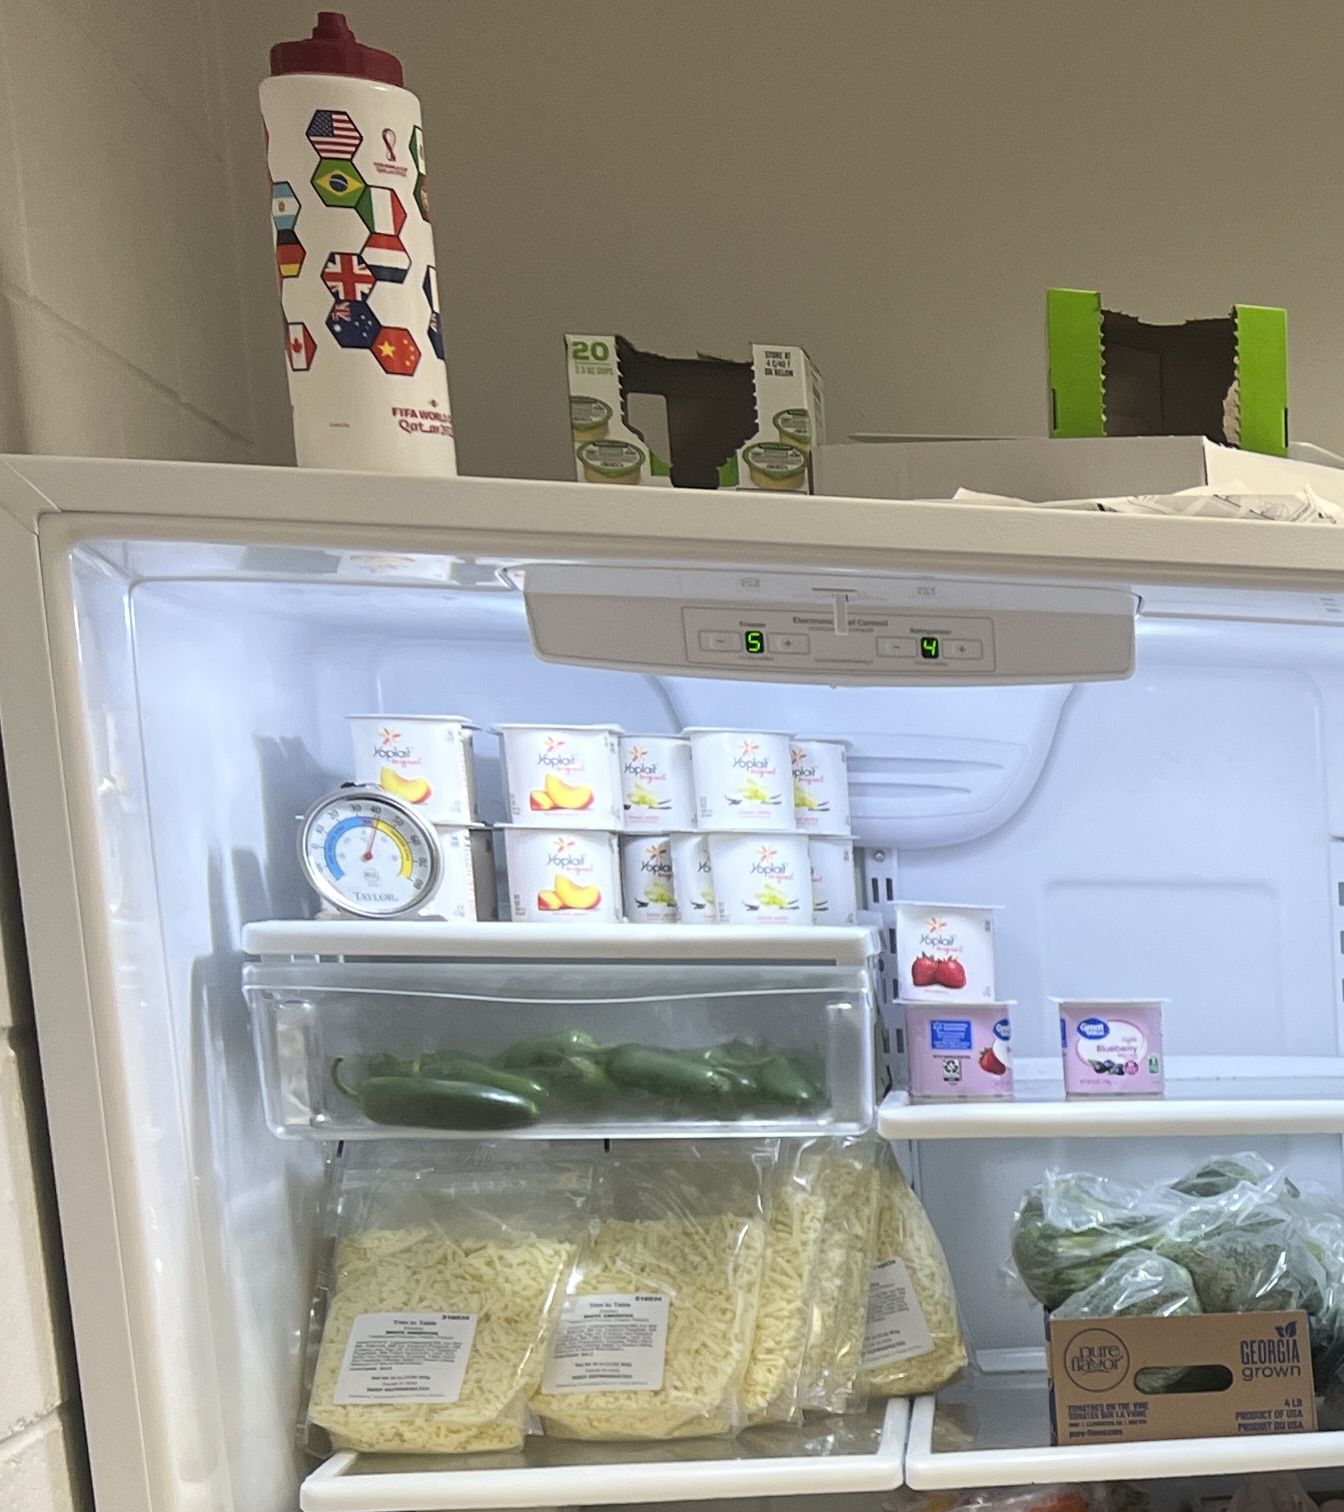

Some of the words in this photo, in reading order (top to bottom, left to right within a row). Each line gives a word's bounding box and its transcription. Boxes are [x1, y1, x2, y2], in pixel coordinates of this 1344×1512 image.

[572, 341, 609, 361] 20
[391, 407, 418, 418] FIFA
[748, 633, 761, 652] 5
[923, 639, 936, 655] 4
[353, 891, 398, 902] TAYLOR
[1079, 1344, 1121, 1360] pure
[1240, 1338, 1300, 1365] GEORGIA
[1241, 1364, 1301, 1382] grown
[1236, 1411, 1272, 1421] PRODUCT
[1274, 1410, 1285, 1420] OF
[1287, 1409, 1304, 1419] USA
[1238, 1422, 1274, 1432] PRODUIT
[1287, 1420, 1304, 1430] USA
